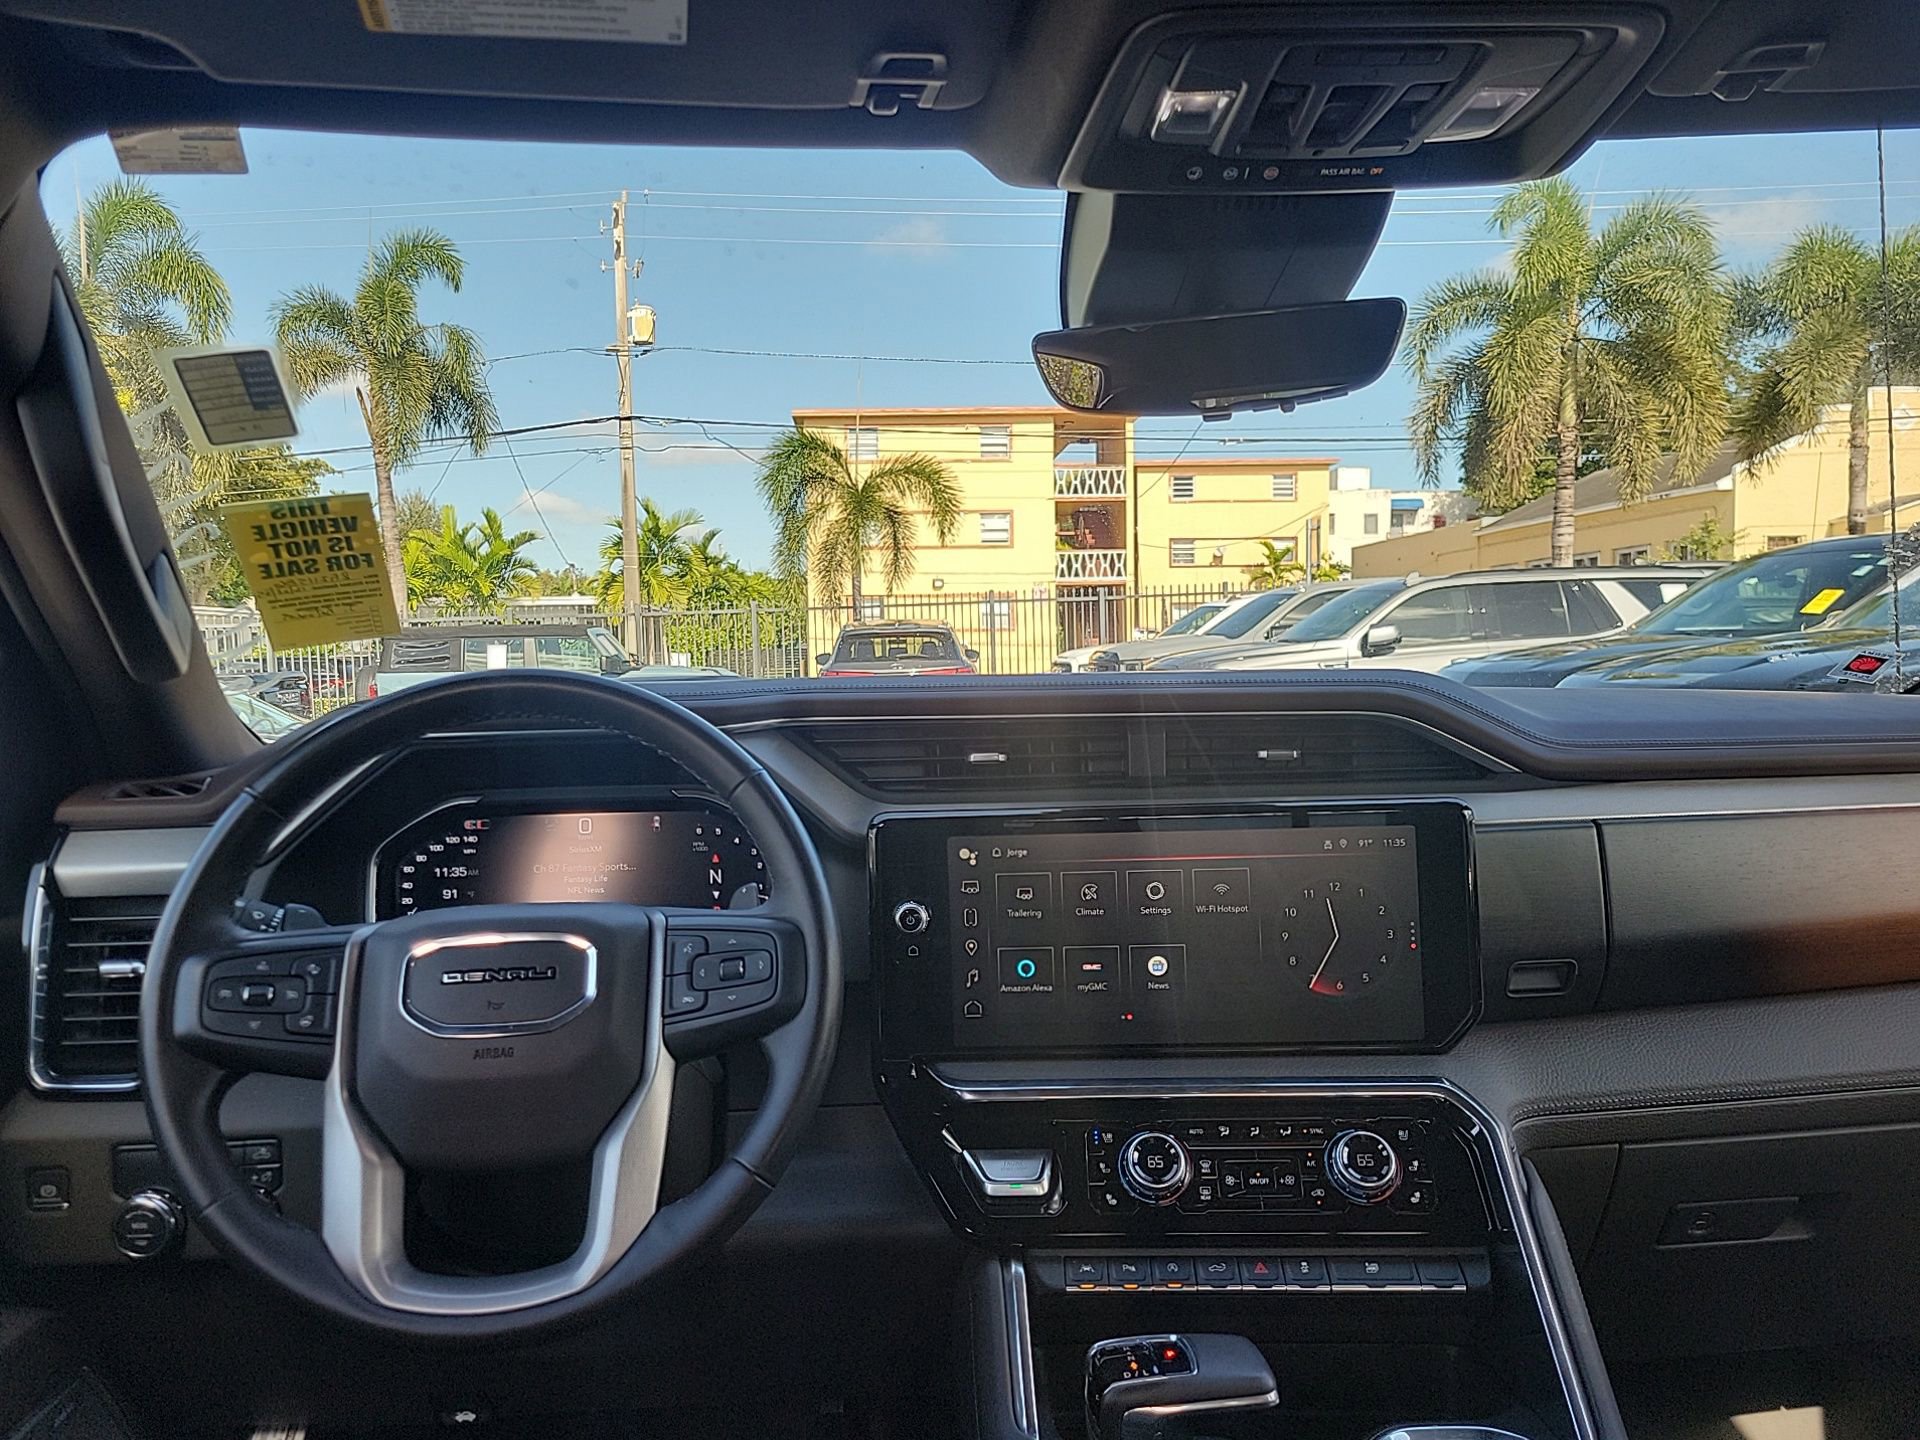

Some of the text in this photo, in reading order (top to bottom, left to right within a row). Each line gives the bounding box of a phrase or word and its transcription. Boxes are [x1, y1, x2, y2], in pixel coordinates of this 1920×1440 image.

[1383, 839, 1406, 847] 11:35
[1006, 848, 1028, 857] Jorge
[434, 867, 467, 877] 11:35
[533, 864, 546, 873] Ch
[709, 869, 722, 884] N
[584, 886, 605, 894] News
[1329, 882, 1341, 891] 12
[442, 889, 458, 899] 91
[1304, 890, 1314, 898] 11
[1007, 908, 1042, 919] Trailering
[1075, 907, 1105, 916] Climate
[1140, 906, 1172, 916] Settings
[1196, 904, 1249, 914] Wi-Fi Hotspot
[1285, 907, 1297, 917] 10
[1379, 906, 1385, 915] 2
[1282, 932, 1289, 941] 9
[1387, 929, 1394, 938] 3
[1289, 956, 1297, 966] 8
[1380, 955, 1387, 963] 4
[441, 966, 557, 984] DENALI
[1362, 973, 1369, 982] 5
[1000, 983, 1053, 993] Amazon Alexa
[1077, 982, 1108, 993] myGMC
[1147, 982, 1170, 990] News
[1336, 980, 1344, 990] 6
[473, 1047, 514, 1060] AIRBAG
[1147, 1155, 1164, 1168] 65
[1356, 1154, 1375, 1167] 65
